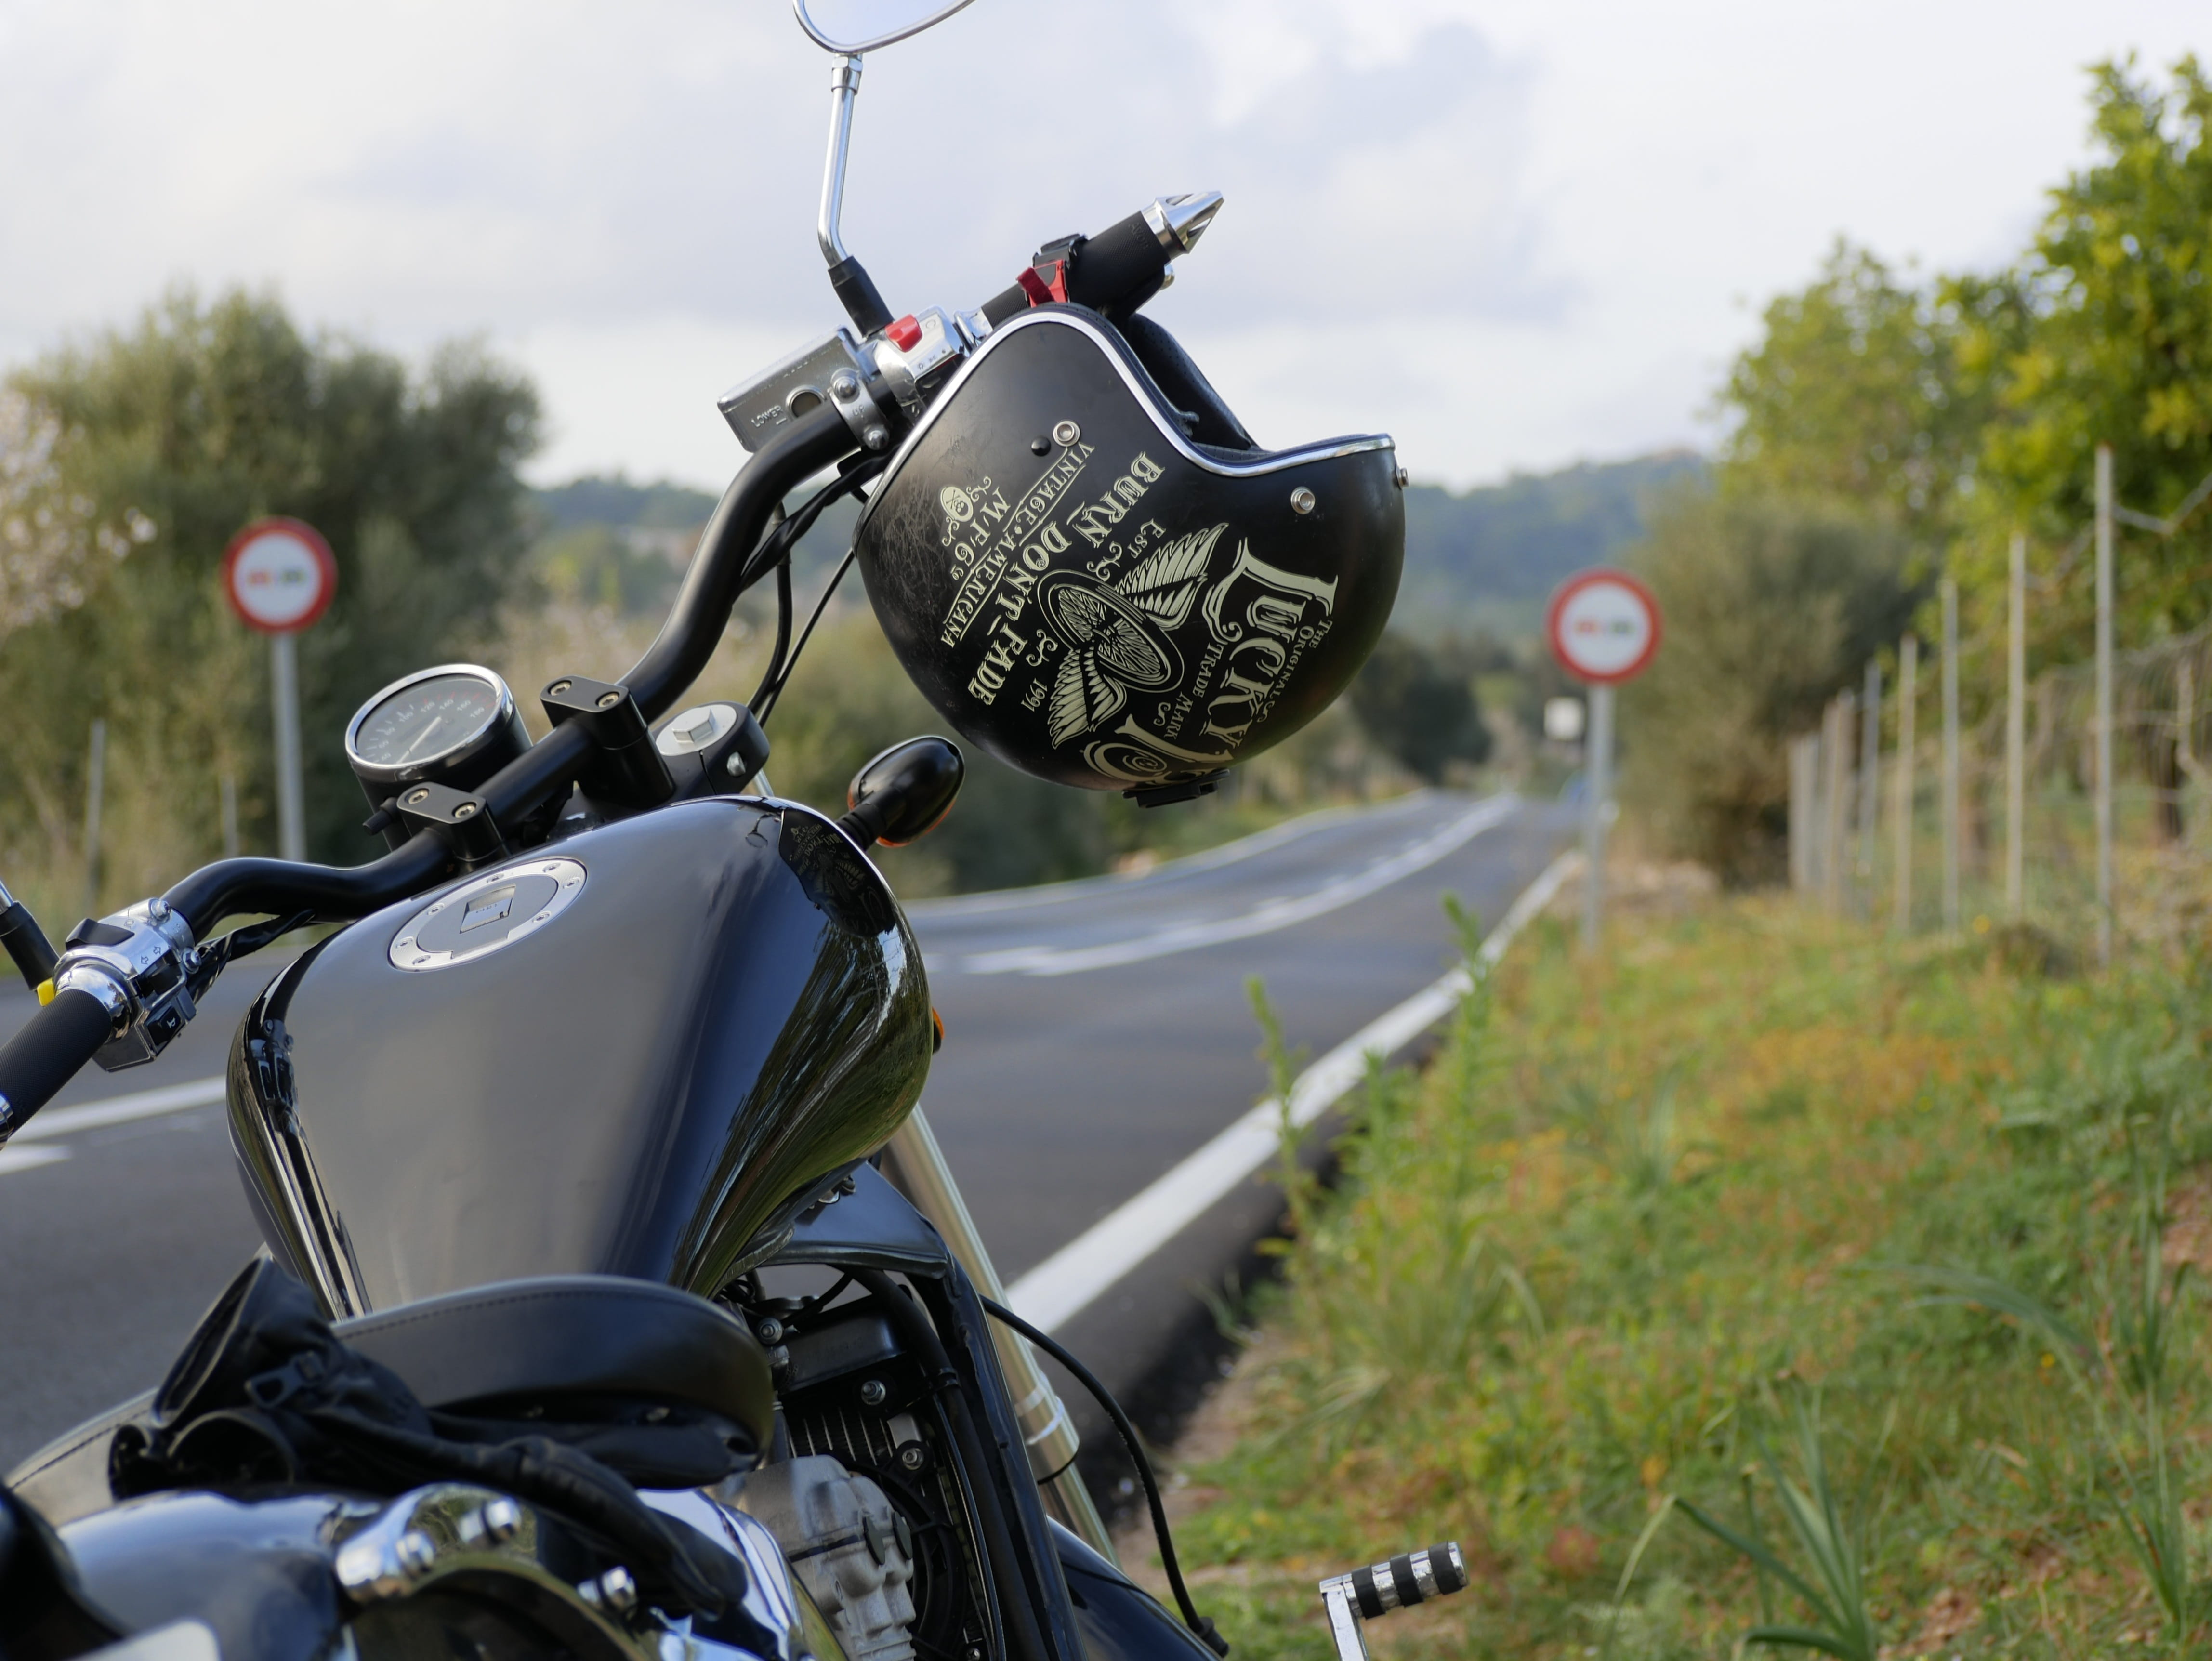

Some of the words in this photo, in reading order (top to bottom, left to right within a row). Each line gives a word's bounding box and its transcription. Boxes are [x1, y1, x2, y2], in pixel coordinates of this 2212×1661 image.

[751, 405, 784, 427] LOWER
[1015, 441, 1095, 526] VINTAGE
[1072, 450, 1166, 549] BURN
[1127, 517, 1166, 559] EST
[940, 531, 1017, 648] AMERICANA
[995, 520, 1072, 621] DON'T
[1199, 537, 1338, 748] LUCKY
[1271, 626, 1315, 697] ORIGINAL
[1309, 619, 1333, 649] THE
[967, 622, 1028, 706] FADE
[1193, 642, 1224, 698] TRADE
[398, 712, 414, 723] 100
[420, 701, 435, 713] 120
[1021, 678, 1048, 712] 1991
[1163, 691, 1194, 740] MARK
